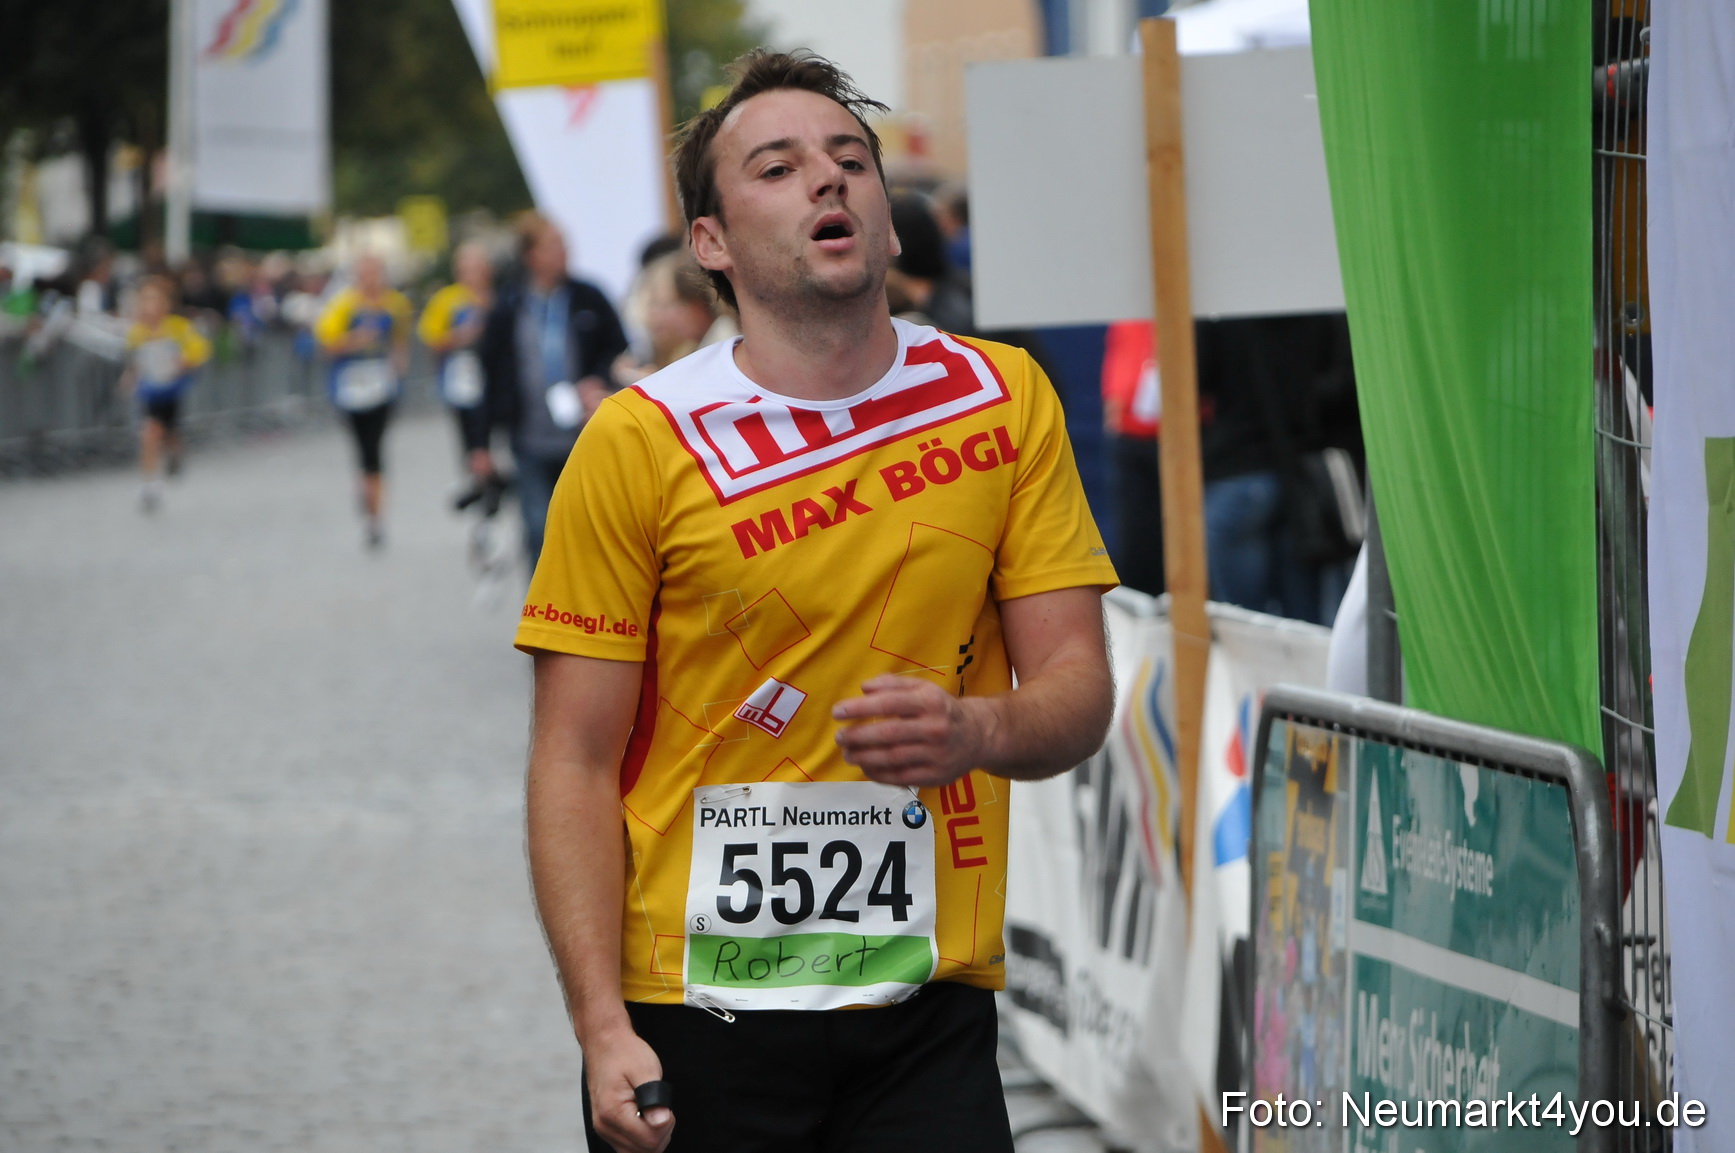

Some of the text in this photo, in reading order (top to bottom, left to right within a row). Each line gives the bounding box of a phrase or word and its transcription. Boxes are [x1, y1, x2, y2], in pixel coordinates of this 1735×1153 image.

[730, 425, 1019, 560] MAX BÖGL
[700, 805, 892, 828] PARTL Neumarkt
[716, 839, 913, 925] 5524
[712, 936, 880, 982] Robert
